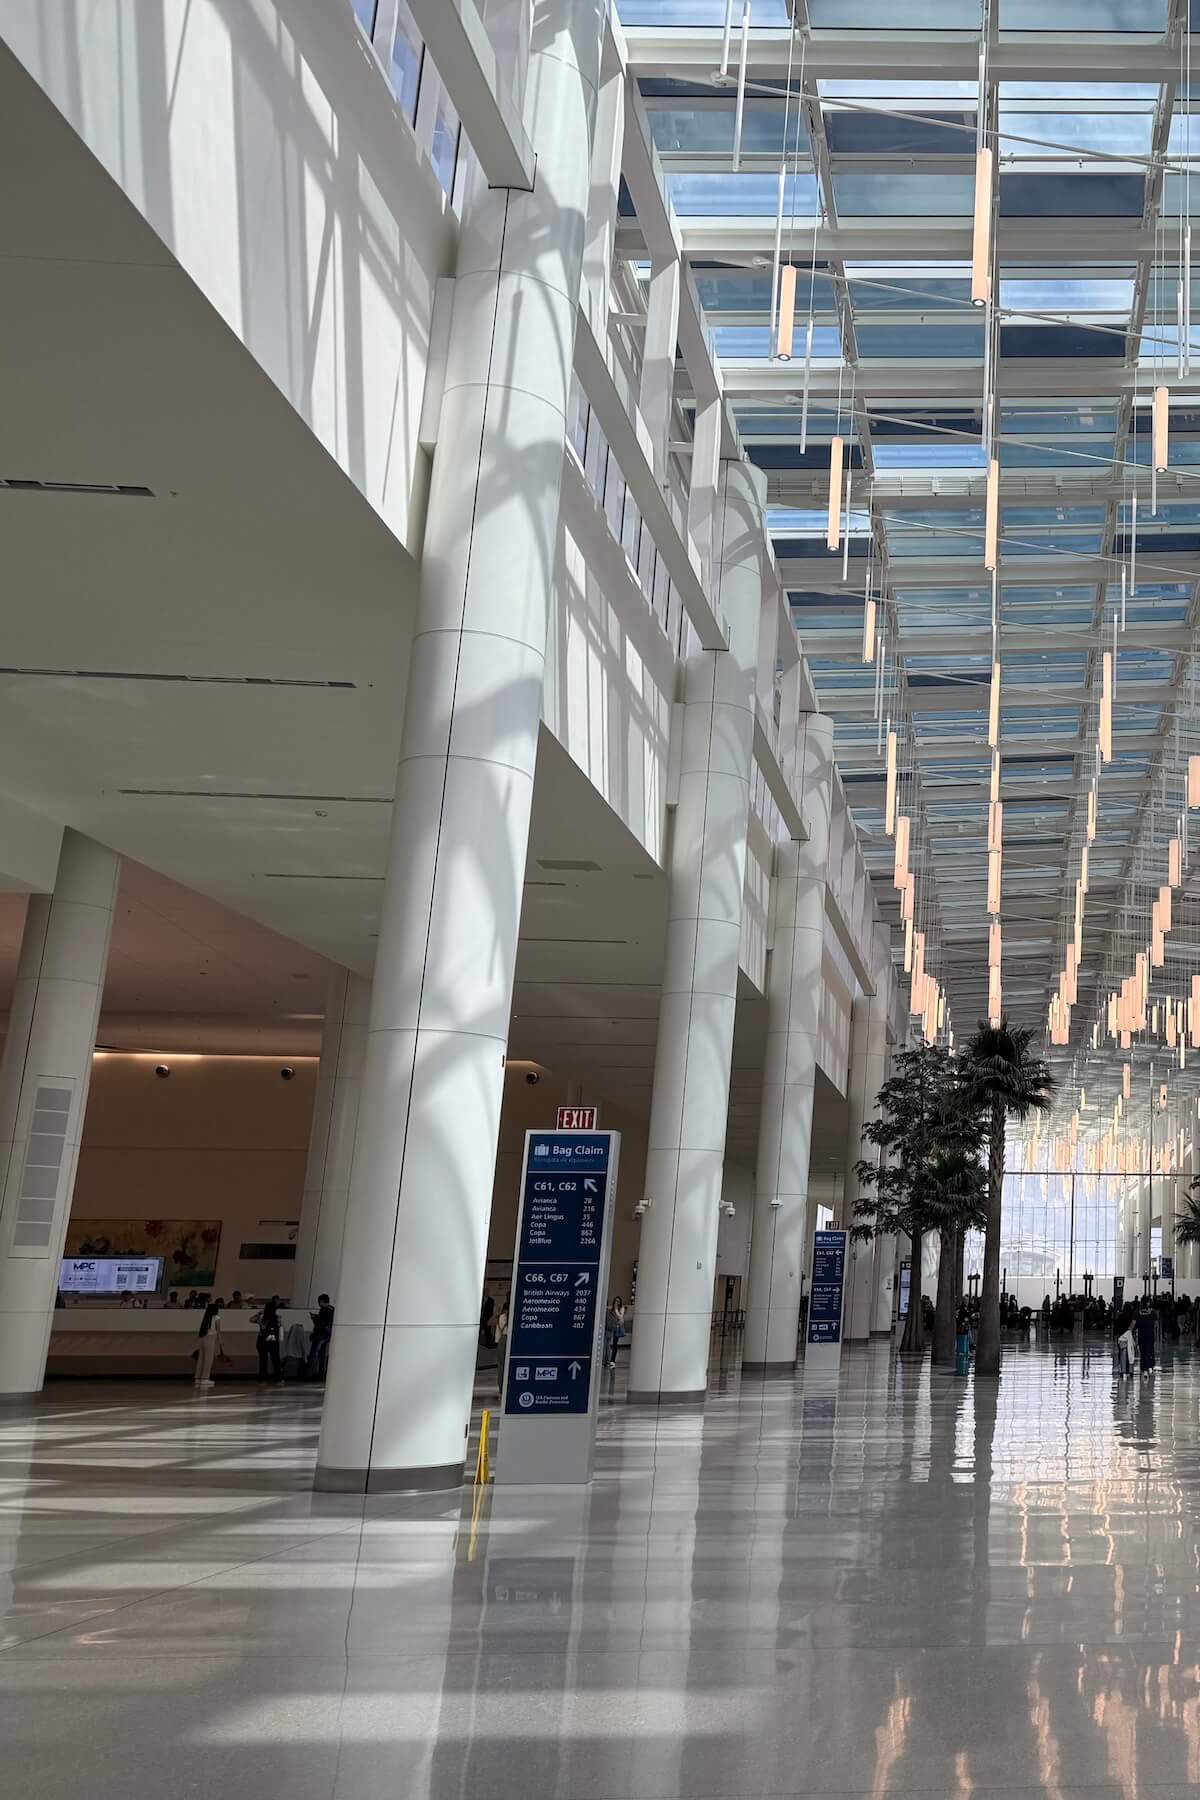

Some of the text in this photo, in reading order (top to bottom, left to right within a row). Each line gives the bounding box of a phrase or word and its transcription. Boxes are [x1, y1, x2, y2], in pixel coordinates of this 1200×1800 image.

[563, 1110, 592, 1128] EXIT
[552, 1144, 604, 1157] Bag Claim
[534, 1182, 577, 1192] C61, C62
[74, 1262, 96, 1270] MPC
[525, 1273, 569, 1283] C66, C67
